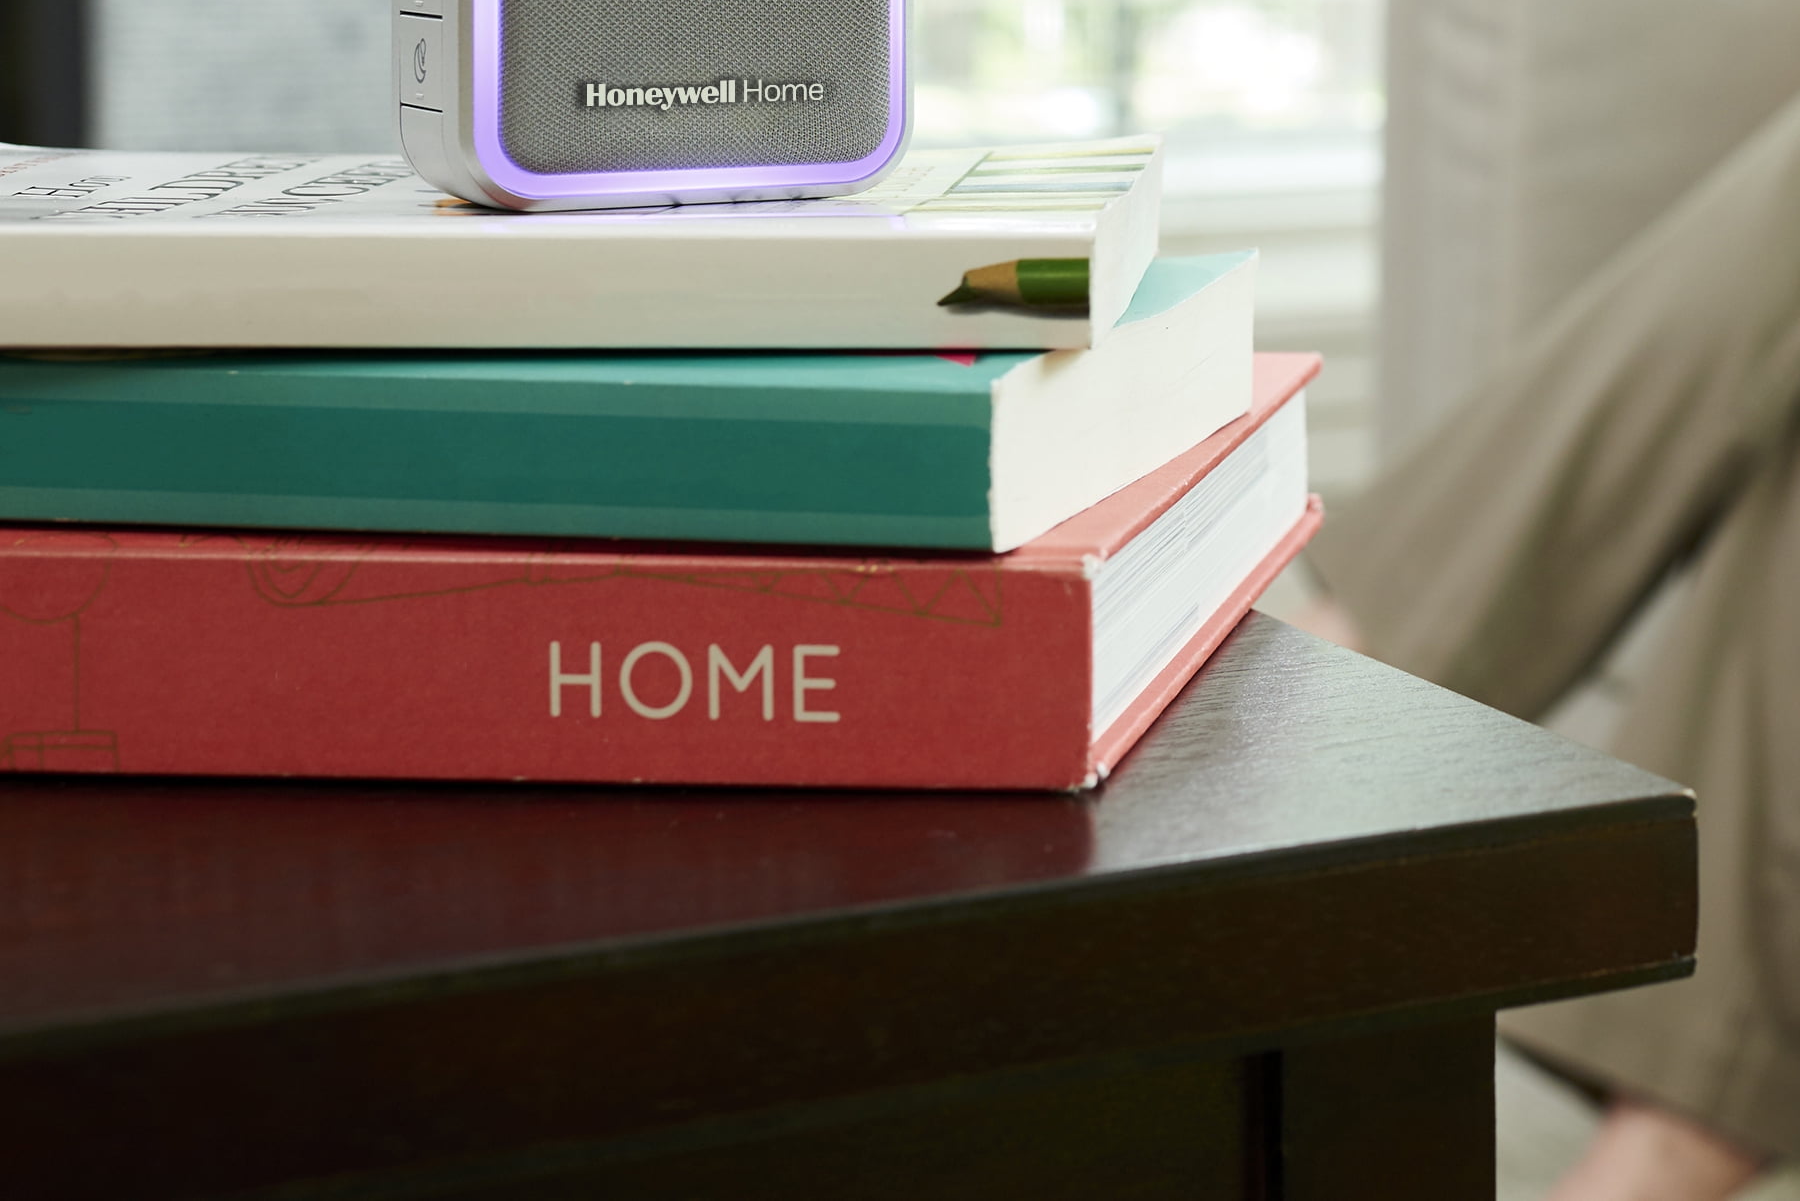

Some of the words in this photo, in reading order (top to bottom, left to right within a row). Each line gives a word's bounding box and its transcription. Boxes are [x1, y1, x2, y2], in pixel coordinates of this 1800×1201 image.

[586, 80, 736, 111] Honeywell
[743, 79, 825, 103] Home
[549, 640, 841, 723] HOME
